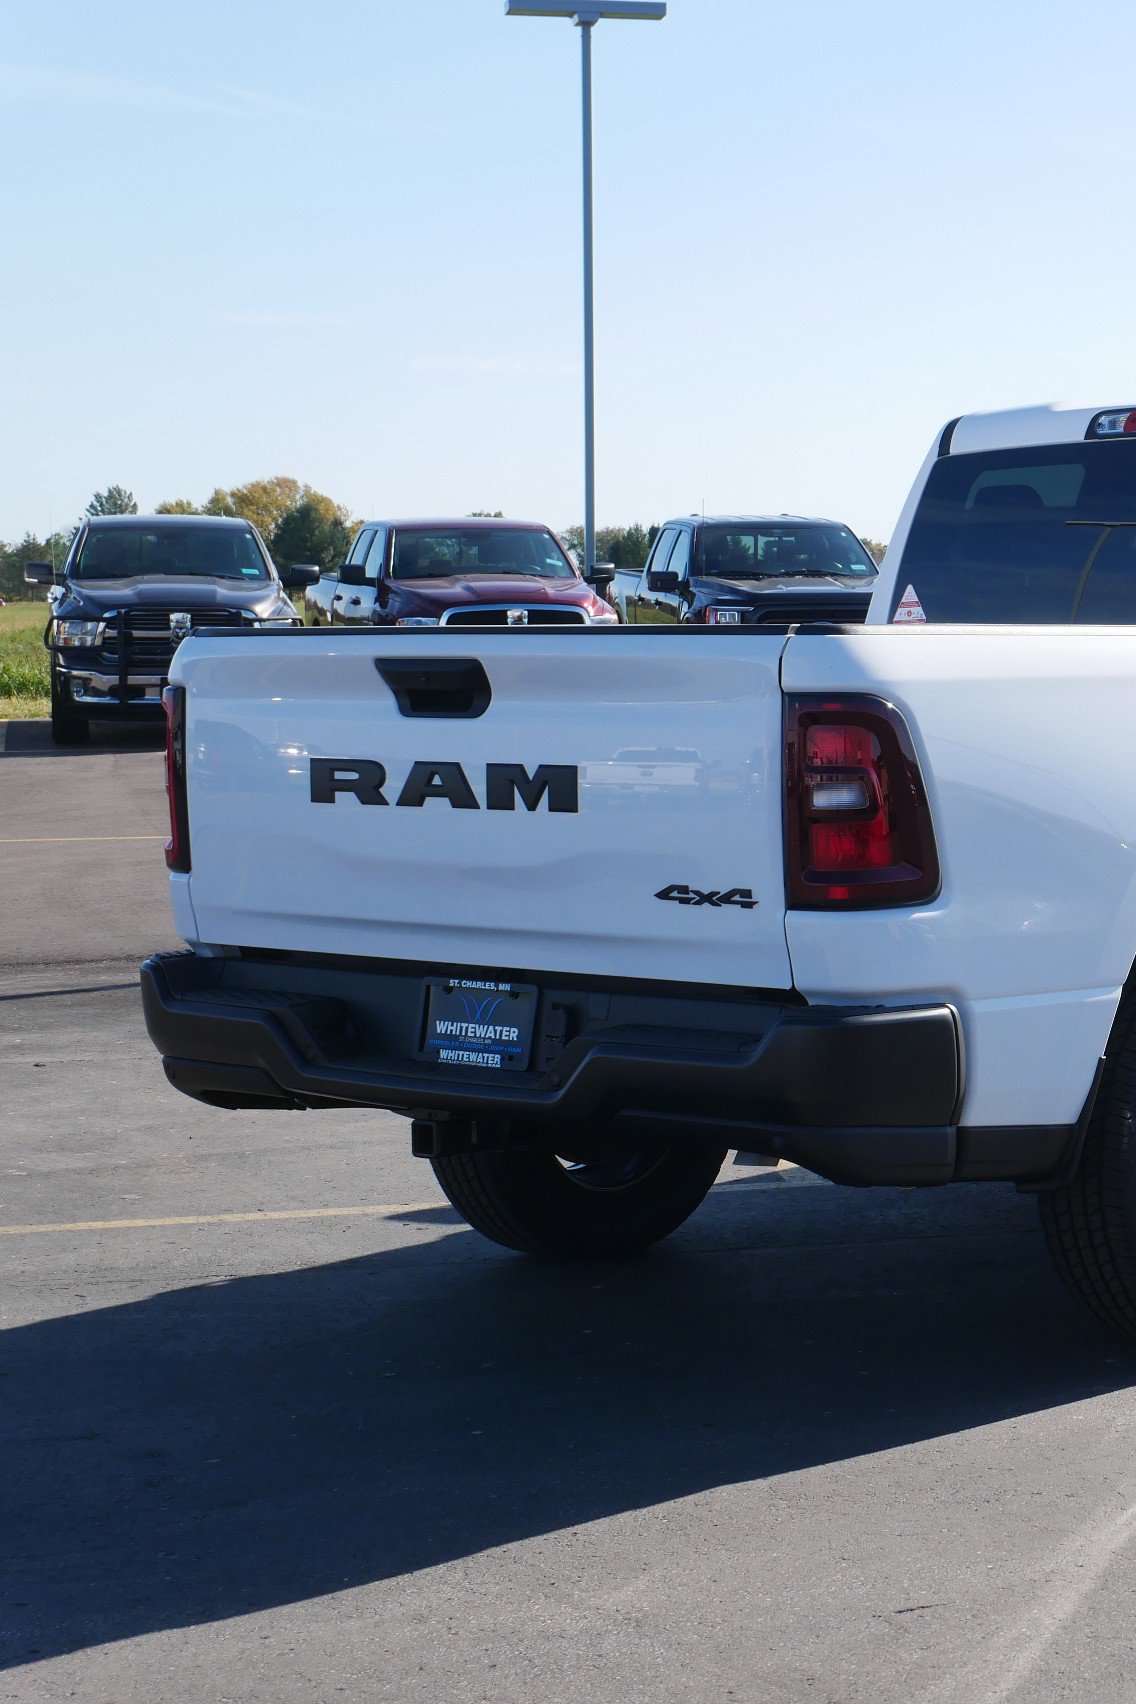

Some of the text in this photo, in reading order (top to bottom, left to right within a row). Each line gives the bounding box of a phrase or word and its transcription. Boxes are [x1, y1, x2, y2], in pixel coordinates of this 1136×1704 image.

[310, 757, 578, 813] RAM
[449, 979, 511, 991] ST. CHARLES, MN
[436, 1020, 519, 1041] WHITEWATER
[439, 1049, 501, 1064] WHITEWATER
